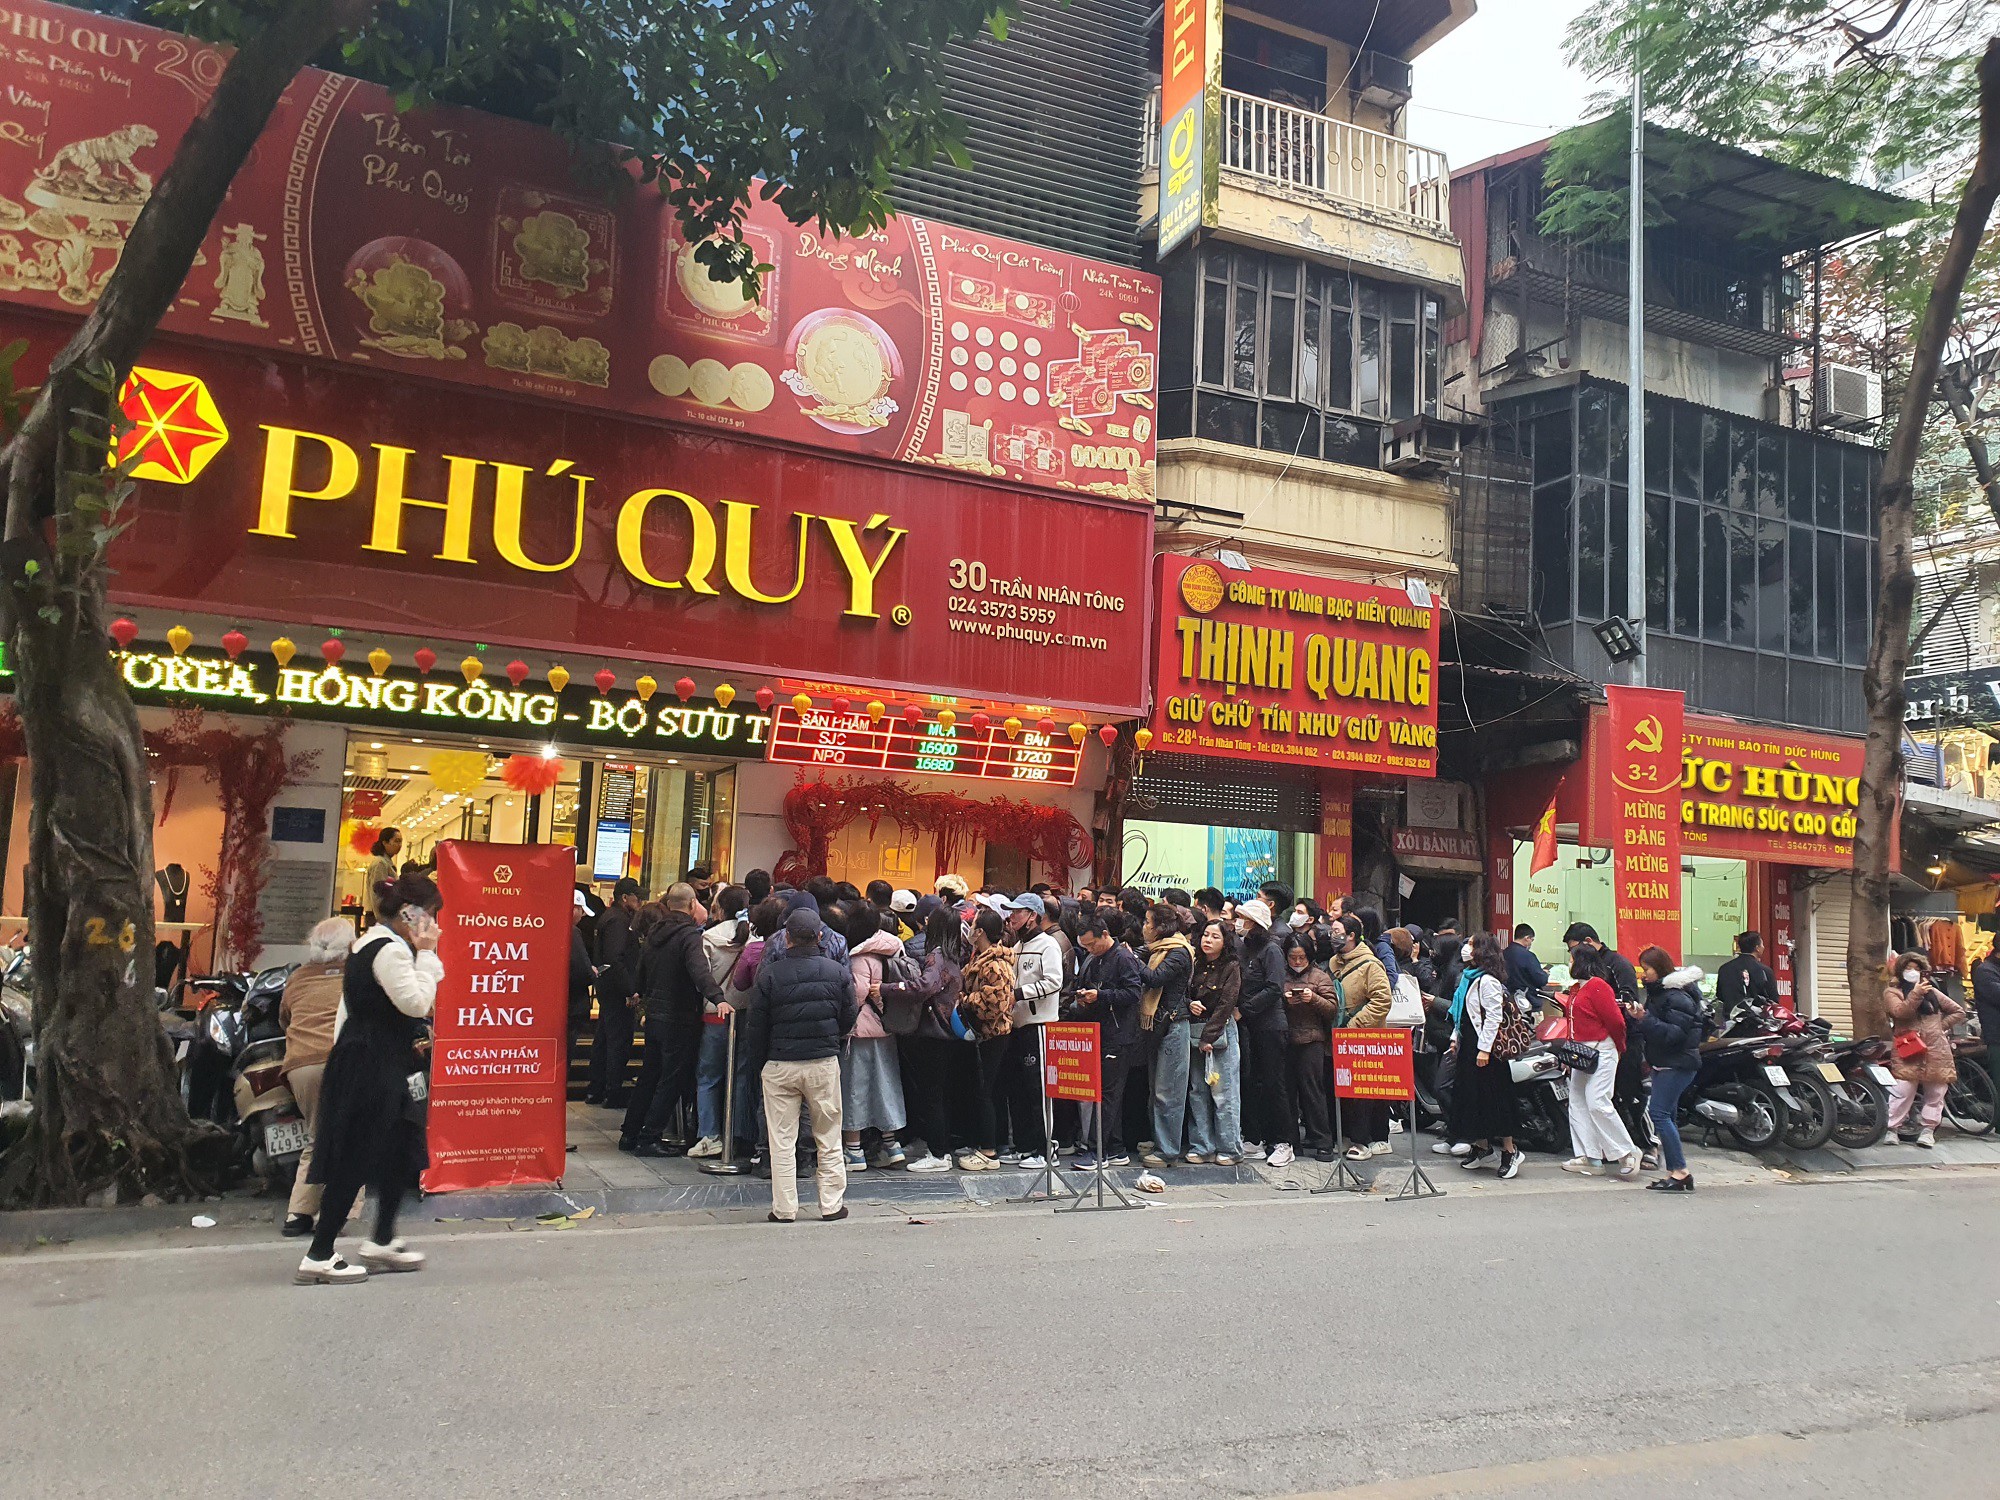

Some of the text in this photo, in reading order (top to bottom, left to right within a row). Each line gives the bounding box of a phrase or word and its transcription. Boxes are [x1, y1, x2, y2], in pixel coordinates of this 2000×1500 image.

[71, 28, 148, 63] QUÝ
[363, 154, 473, 214] Phú Quý
[941, 235, 1030, 272] Phú Quý Cát
[247, 423, 909, 619] PHÚ QUÝ
[949, 558, 1125, 612] 30 TRẦN NHÂN TÔNG
[948, 596, 1057, 624] 024 3573 5959
[1229, 580, 1266, 606] CÔNG
[1269, 588, 1286, 608] TY
[1289, 589, 1322, 615] VÀNG
[1327, 598, 1352, 621] BẠC
[1390, 606, 1431, 630] QUANG
[949, 618, 1108, 650] www.phuquy.com.vn
[1177, 616, 1431, 706] THỊNH QUANG
[109, 650, 270, 704] OREA,
[586, 698, 648, 738] BỘ
[656, 706, 740, 739] SƯU
[1168, 695, 1437, 748] GIỮ CHỮ TÍN NHƯ GIỮ VÀNG
[818, 732, 847, 745] SJC
[1258, 742, 1270, 753] Tel:
[1689, 734, 1703, 745] TY
[1707, 736, 1735, 749] TNHH
[1739, 739, 1761, 753] BẢO
[1764, 741, 1780, 754] TÍN
[1784, 745, 1807, 759] ĐỨC
[1811, 749, 1840, 762] HÙNG
[813, 749, 846, 764] NPQ
[915, 757, 954, 771] 16880
[1681, 746, 1733, 793] ỨC
[1628, 764, 1658, 781] 3-2
[1624, 798, 1666, 820] MỪNG
[1699, 802, 1755, 829] TRANG
[1757, 803, 1789, 833] SỨC
[1794, 811, 1827, 836] CAO
[1396, 829, 1458, 854] XÔI BÁNH
[1624, 824, 1666, 846] ĐẢNG
[1684, 831, 1708, 842] TÔNG
[1625, 852, 1669, 873] MỪNG
[1528, 883, 1559, 895] Mua Bán
[1625, 881, 1669, 900] XUÂN
[1495, 893, 1510, 915] MUA
[1527, 898, 1539, 908] Kim
[457, 912, 545, 928] THÔNG BÁO
[1713, 912, 1724, 922] Kim
[469, 941, 529, 965] TẠM
[1778, 952, 1789, 971] TÁC
[470, 969, 525, 994] HẾT
[1776, 977, 1791, 996] VÀNG
[457, 1003, 534, 1027] HÀNG
[447, 1045, 539, 1060] CÁC SẢN PHẨM
[1348, 1044, 1366, 1057] NGHỊ
[1366, 1042, 1387, 1056] NHÂN
[1388, 1042, 1404, 1056] DÂN
[445, 1062, 541, 1076] VÀNG TÍCH TRỮ
[470, 1098, 485, 1106] quý
[486, 1097, 510, 1105] khách
[511, 1096, 535, 1105] thông
[490, 1108, 505, 1116] tiện
